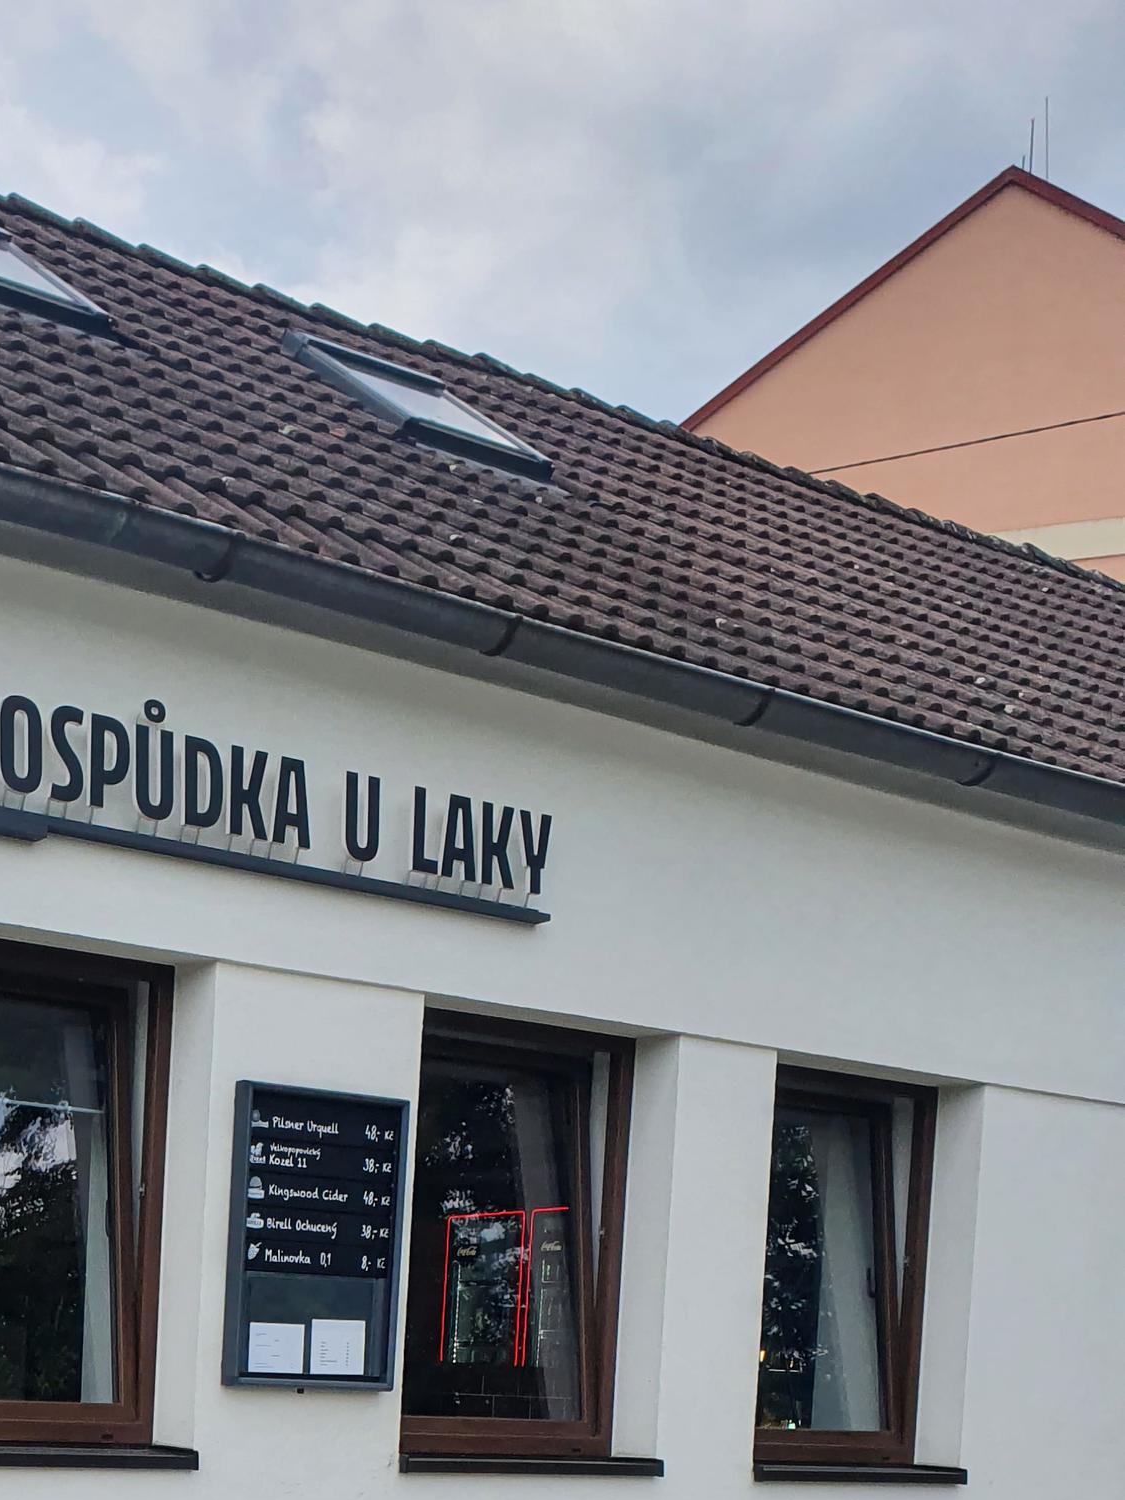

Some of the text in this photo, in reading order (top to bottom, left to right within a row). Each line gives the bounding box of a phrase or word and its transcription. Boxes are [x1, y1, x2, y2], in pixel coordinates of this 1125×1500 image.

[345, 770, 380, 862] U
[412, 786, 552, 894] LAKY
[272, 1116, 304, 1131] Pilsner
[307, 1120, 339, 1138] Urquell
[268, 1154, 294, 1167] Kozel
[297, 1157, 307, 1169] 11
[268, 1184, 319, 1201] Kingswood
[322, 1188, 348, 1202] Cider
[266, 1217, 292, 1230] Birell
[295, 1219, 337, 1239] Ochucený
[264, 1249, 311, 1265] Malinovka
